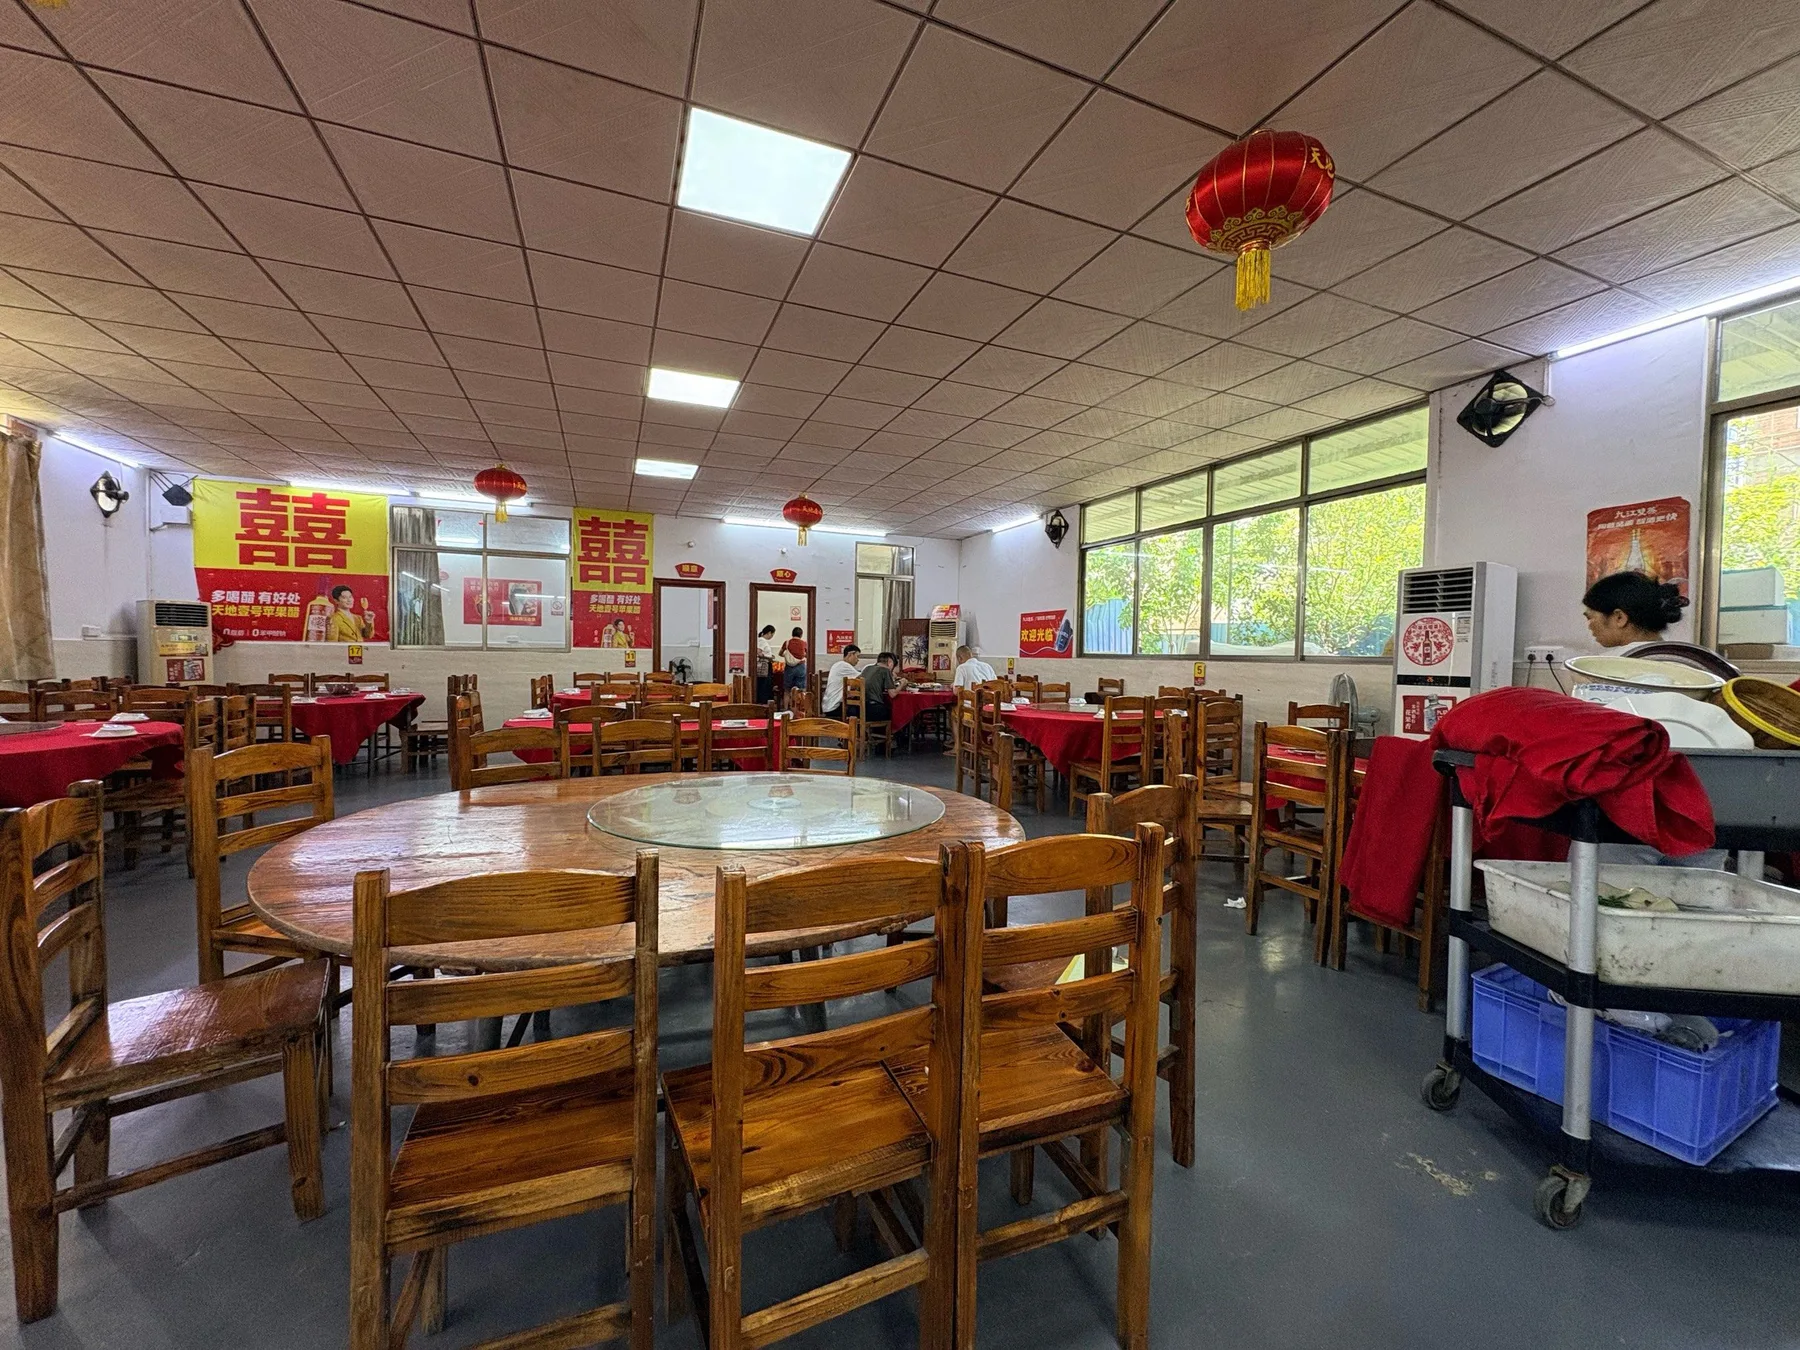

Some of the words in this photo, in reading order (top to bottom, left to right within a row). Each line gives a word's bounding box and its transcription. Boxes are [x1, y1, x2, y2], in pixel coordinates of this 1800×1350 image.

[211, 590, 255, 604] 多喝醋
[258, 591, 301, 605] 有好处
[617, 595, 641, 605] 有好处
[212, 604, 300, 618] 天地壹号苹果醋
[1021, 628, 1053, 642] 欢迎光临
[350, 647, 361, 655] 17
[1197, 666, 1202, 674] 5
